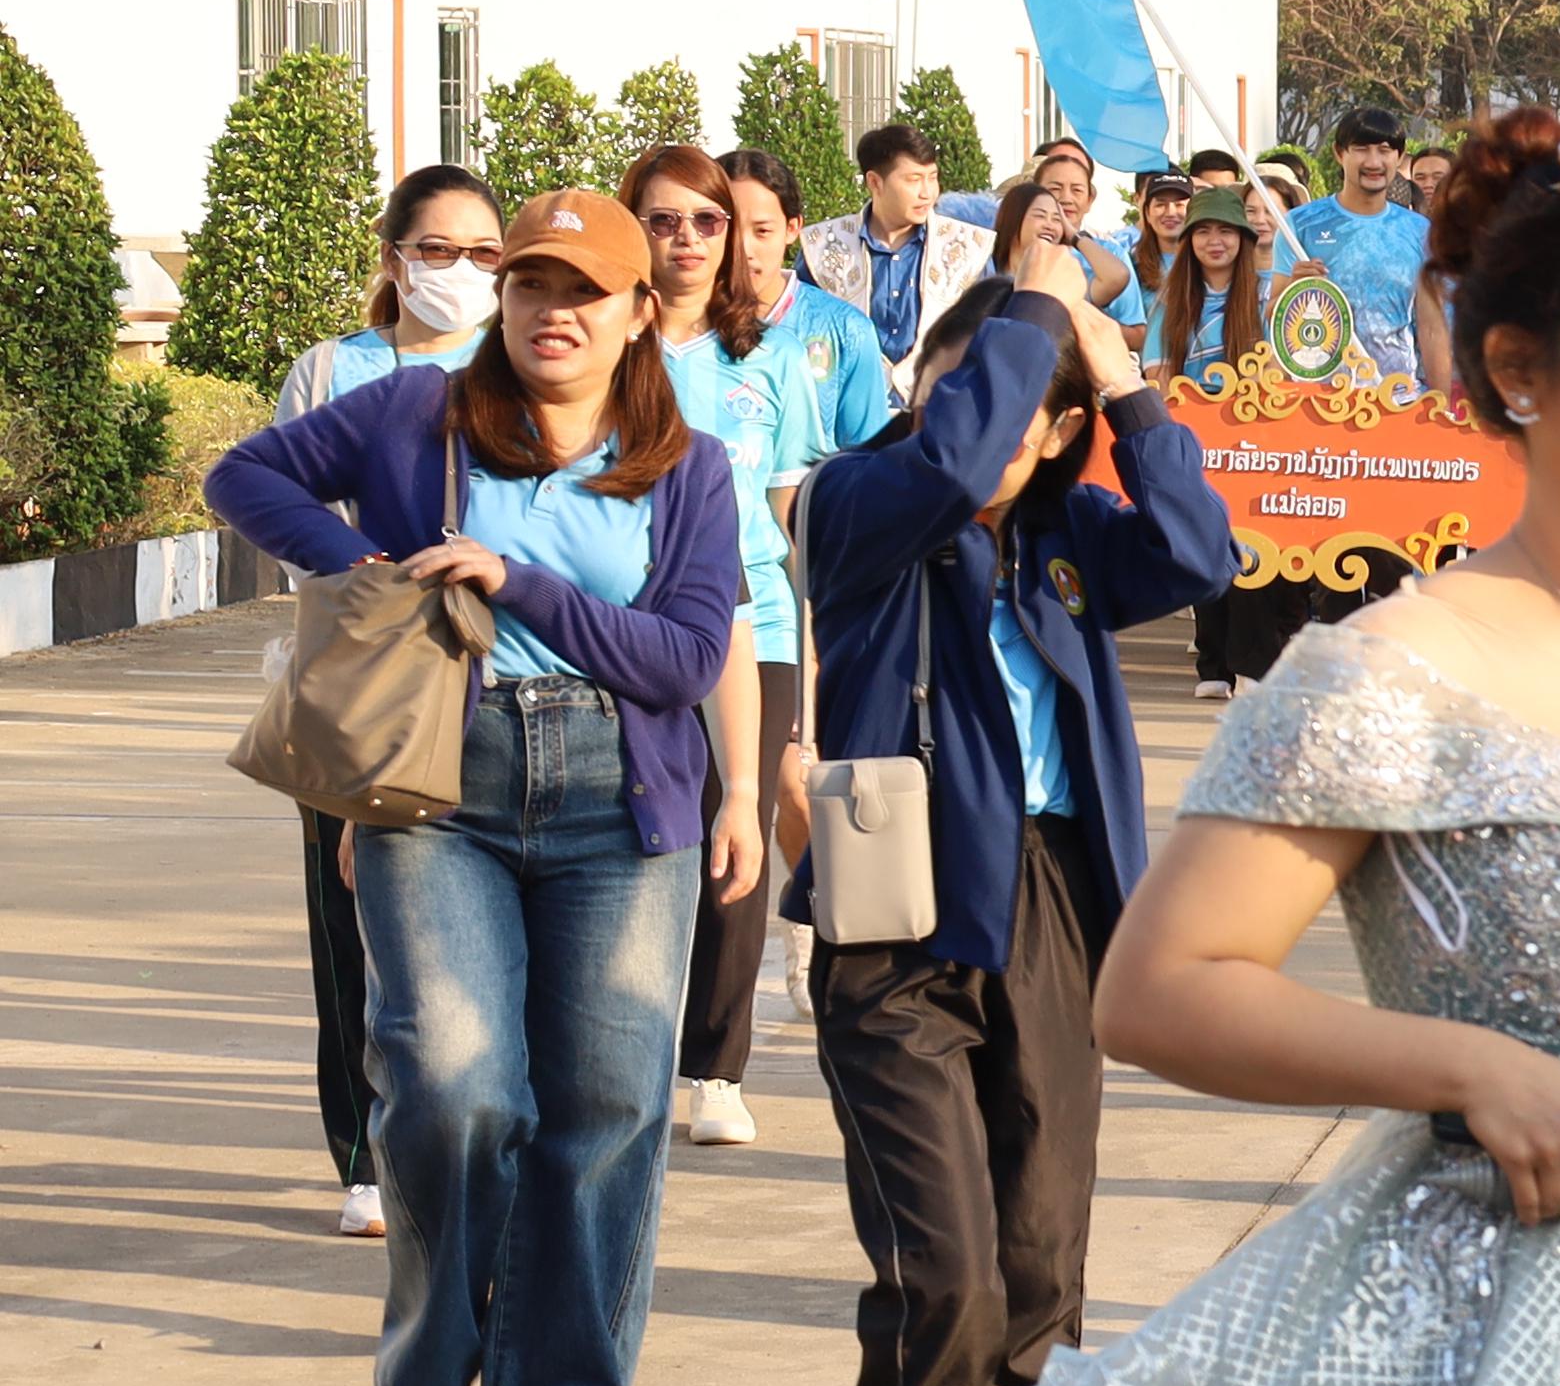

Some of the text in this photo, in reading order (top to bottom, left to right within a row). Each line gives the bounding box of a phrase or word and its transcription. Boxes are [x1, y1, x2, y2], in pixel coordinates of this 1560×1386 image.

[1202, 440, 1480, 482] ยาลัยราชภัฏกำแพงเพชร
[1260, 486, 1347, 519] แม่สอด
